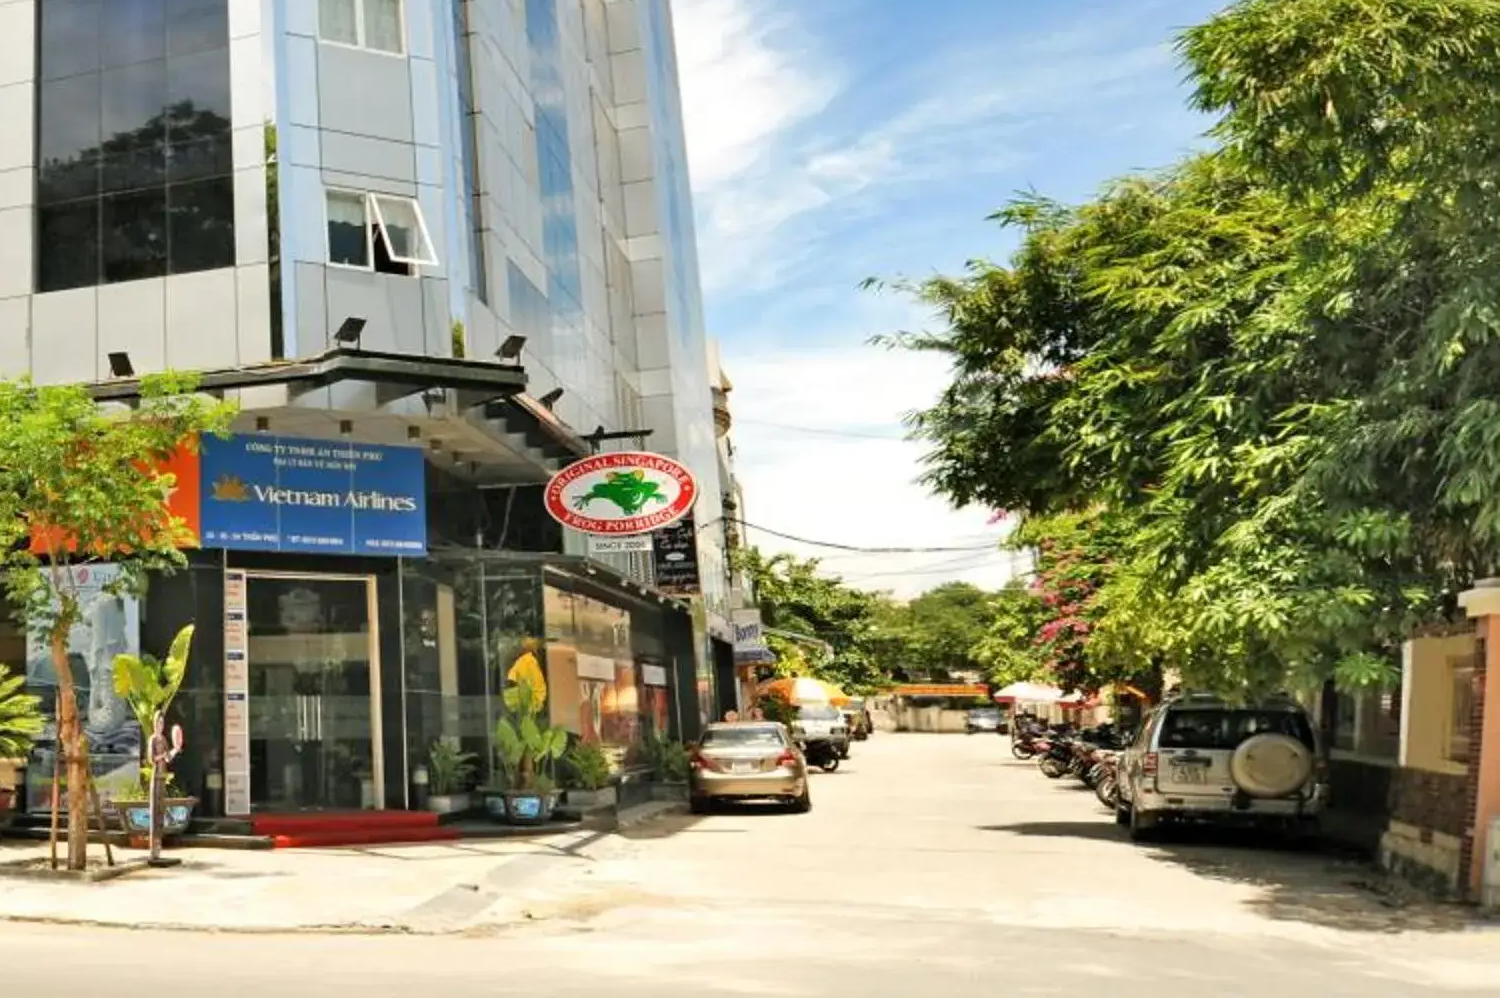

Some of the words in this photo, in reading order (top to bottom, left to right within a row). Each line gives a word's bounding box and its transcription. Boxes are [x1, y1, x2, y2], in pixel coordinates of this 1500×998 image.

[551, 456, 608, 495] ORIGINAL
[612, 456, 690, 485] SINGAPORE
[253, 485, 340, 508] Vietnam
[343, 489, 417, 512] Airlines
[564, 513, 602, 531] FROG
[605, 506, 677, 531] PORRIDGE
